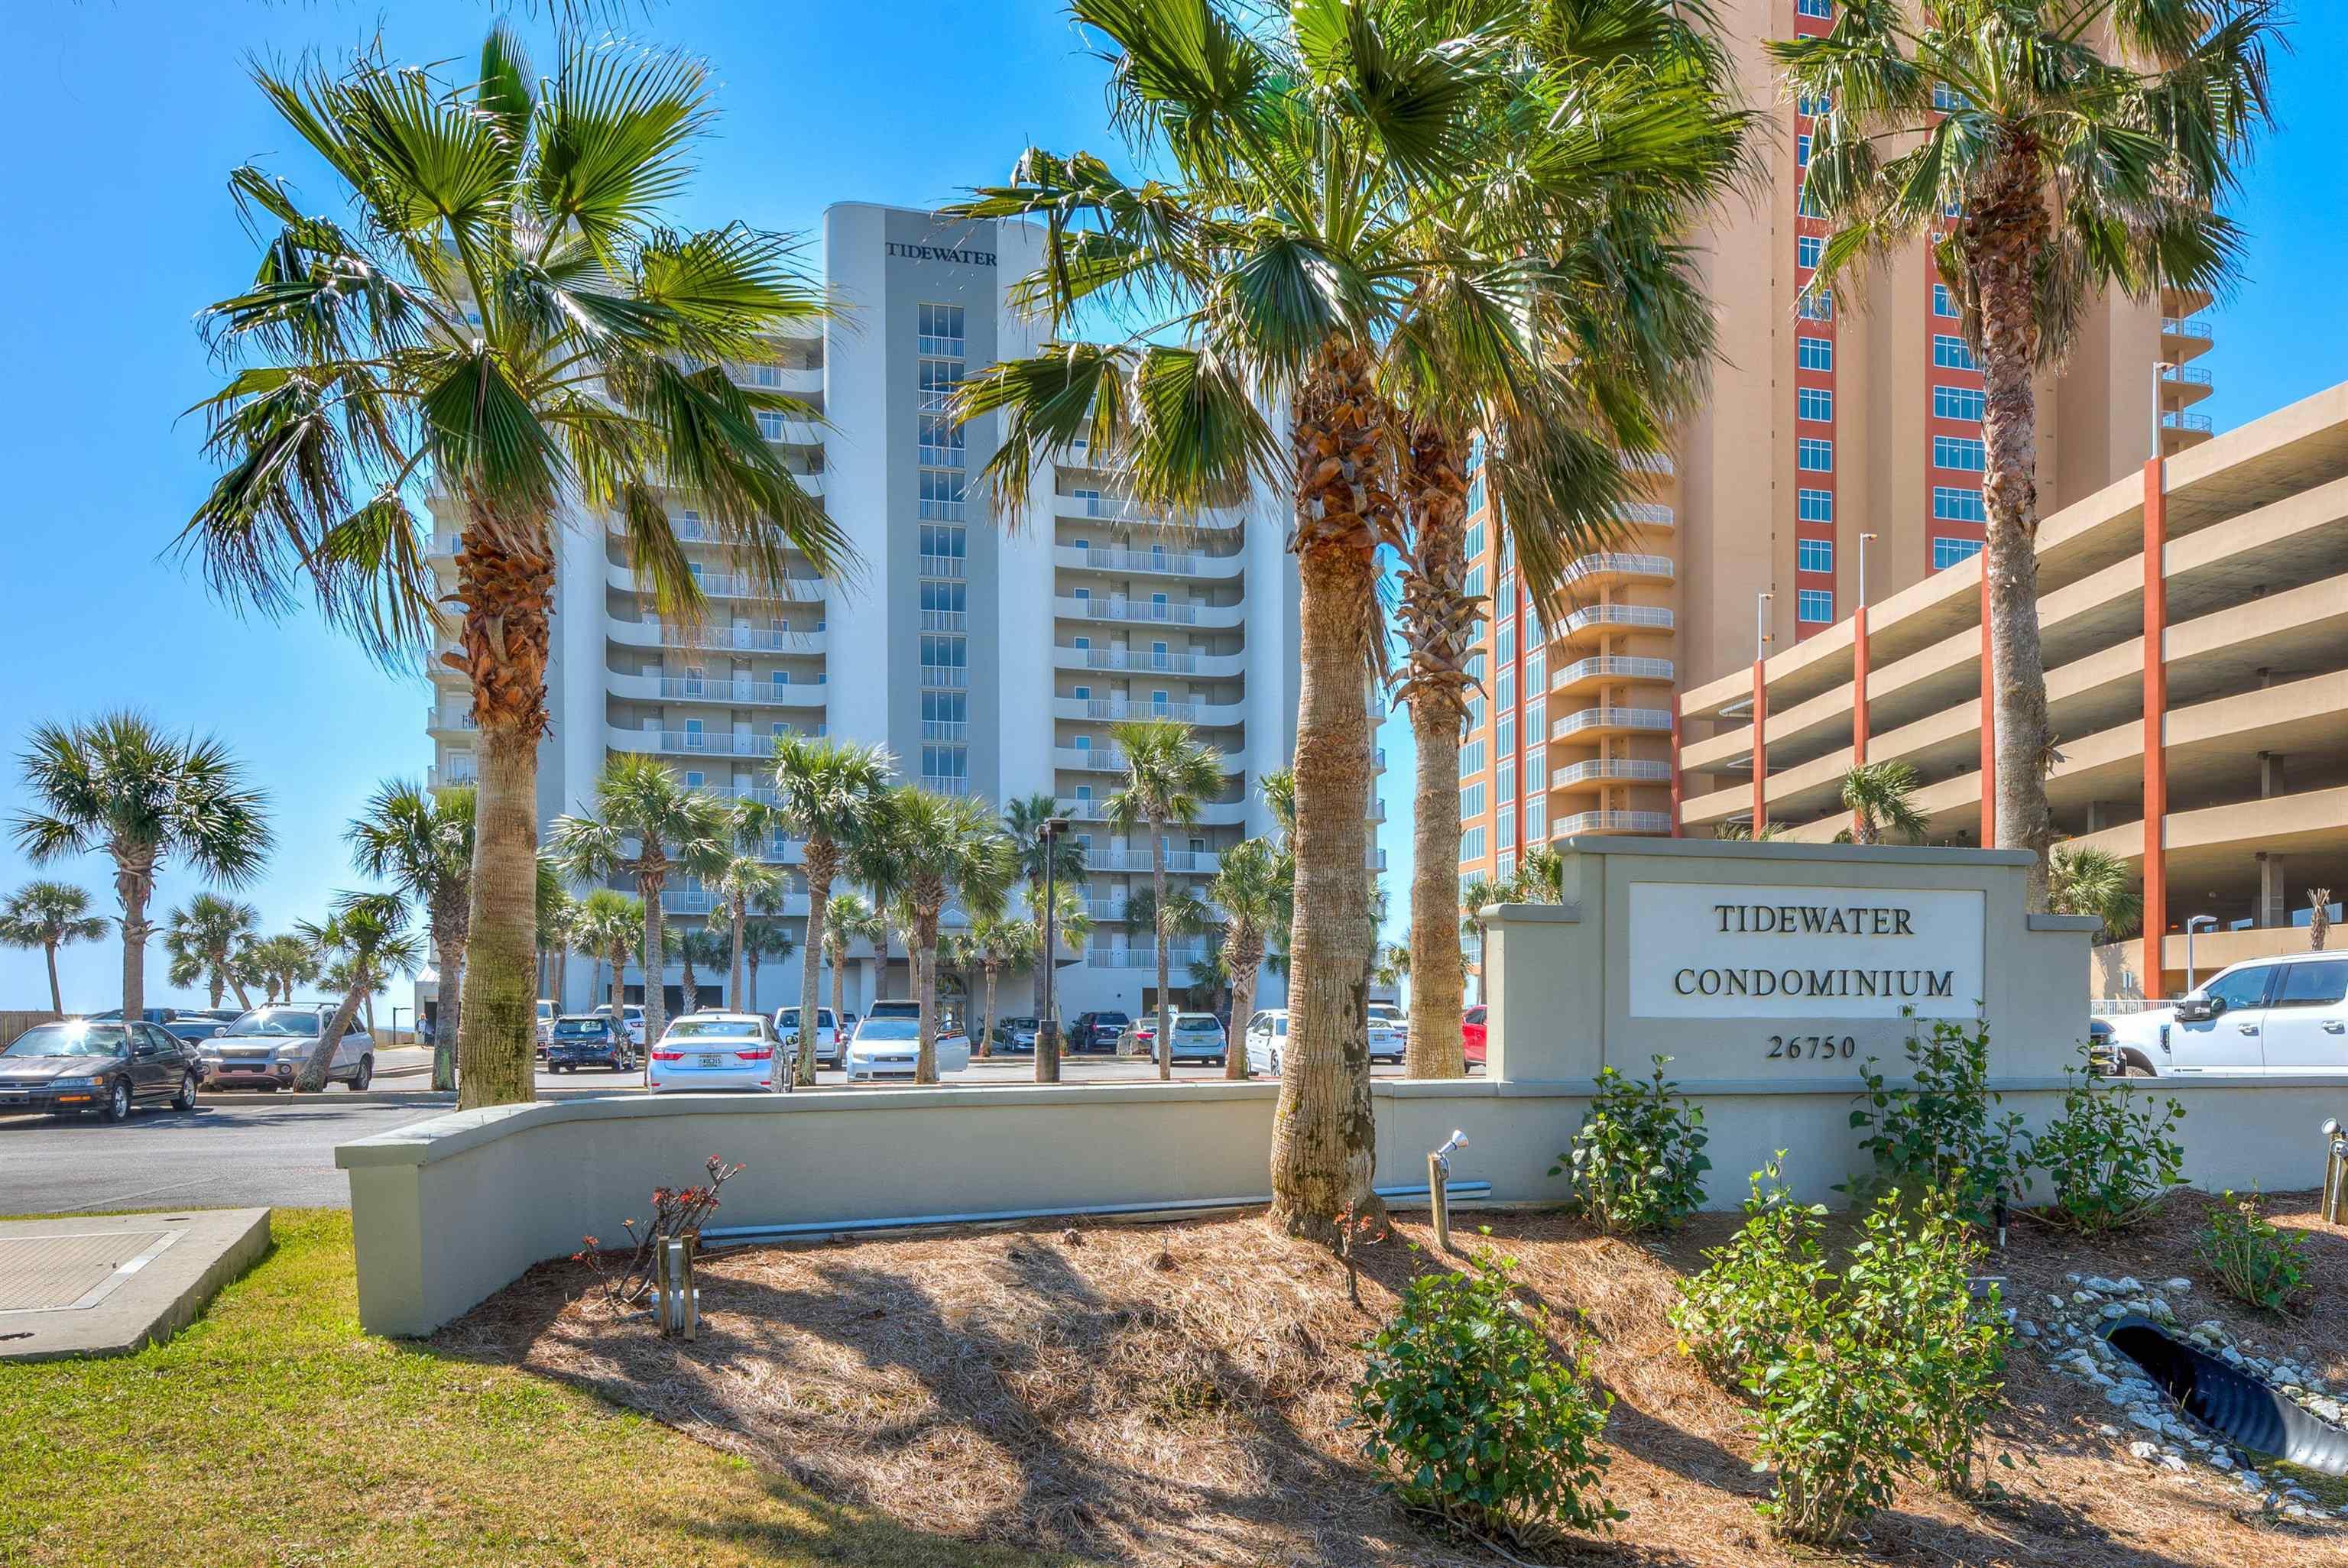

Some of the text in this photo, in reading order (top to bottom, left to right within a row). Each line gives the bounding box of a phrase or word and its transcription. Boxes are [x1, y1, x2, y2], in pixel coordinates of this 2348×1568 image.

[886, 242, 997, 267] TIDEWATER
[1714, 905, 1915, 935] TIDEWATER
[1675, 968, 1954, 997] CONDOMINIUM
[1767, 1035, 1856, 1059] 26750
